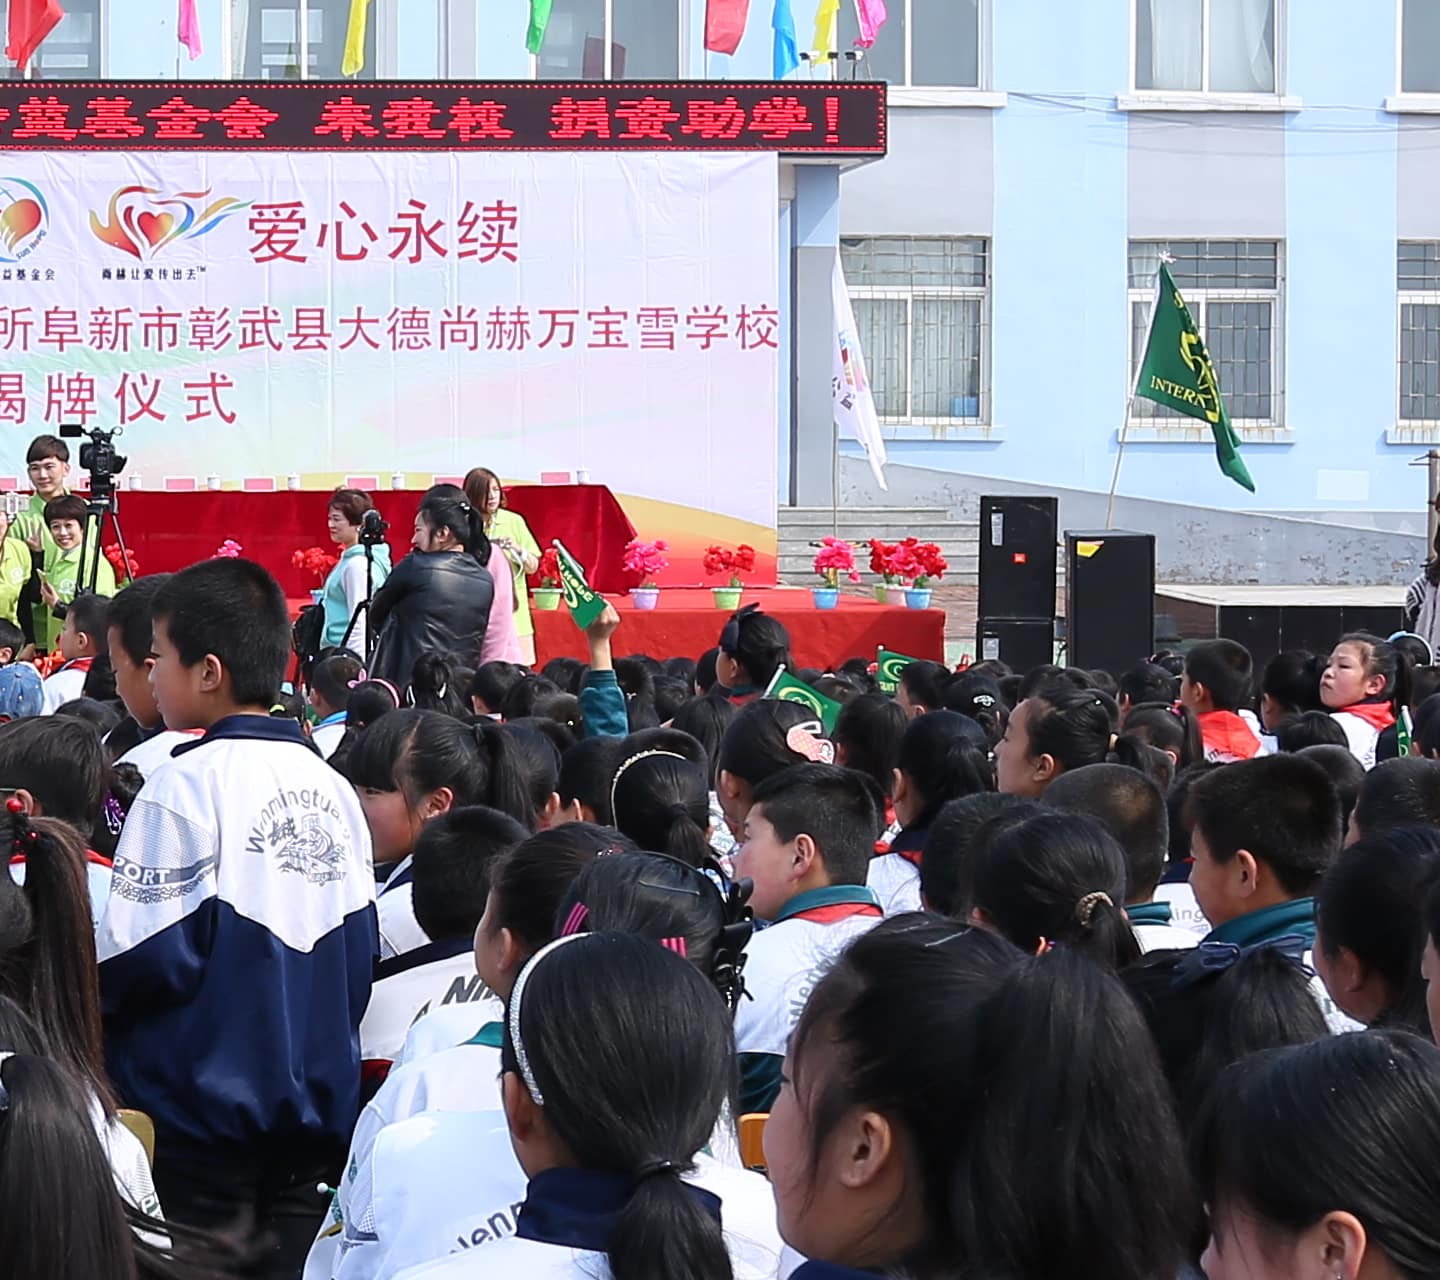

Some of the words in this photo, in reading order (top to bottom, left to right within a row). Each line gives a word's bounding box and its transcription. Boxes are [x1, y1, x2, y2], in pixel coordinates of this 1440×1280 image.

[248, 198, 520, 264] 爱心永续
[112, 854, 172, 886] PORT
